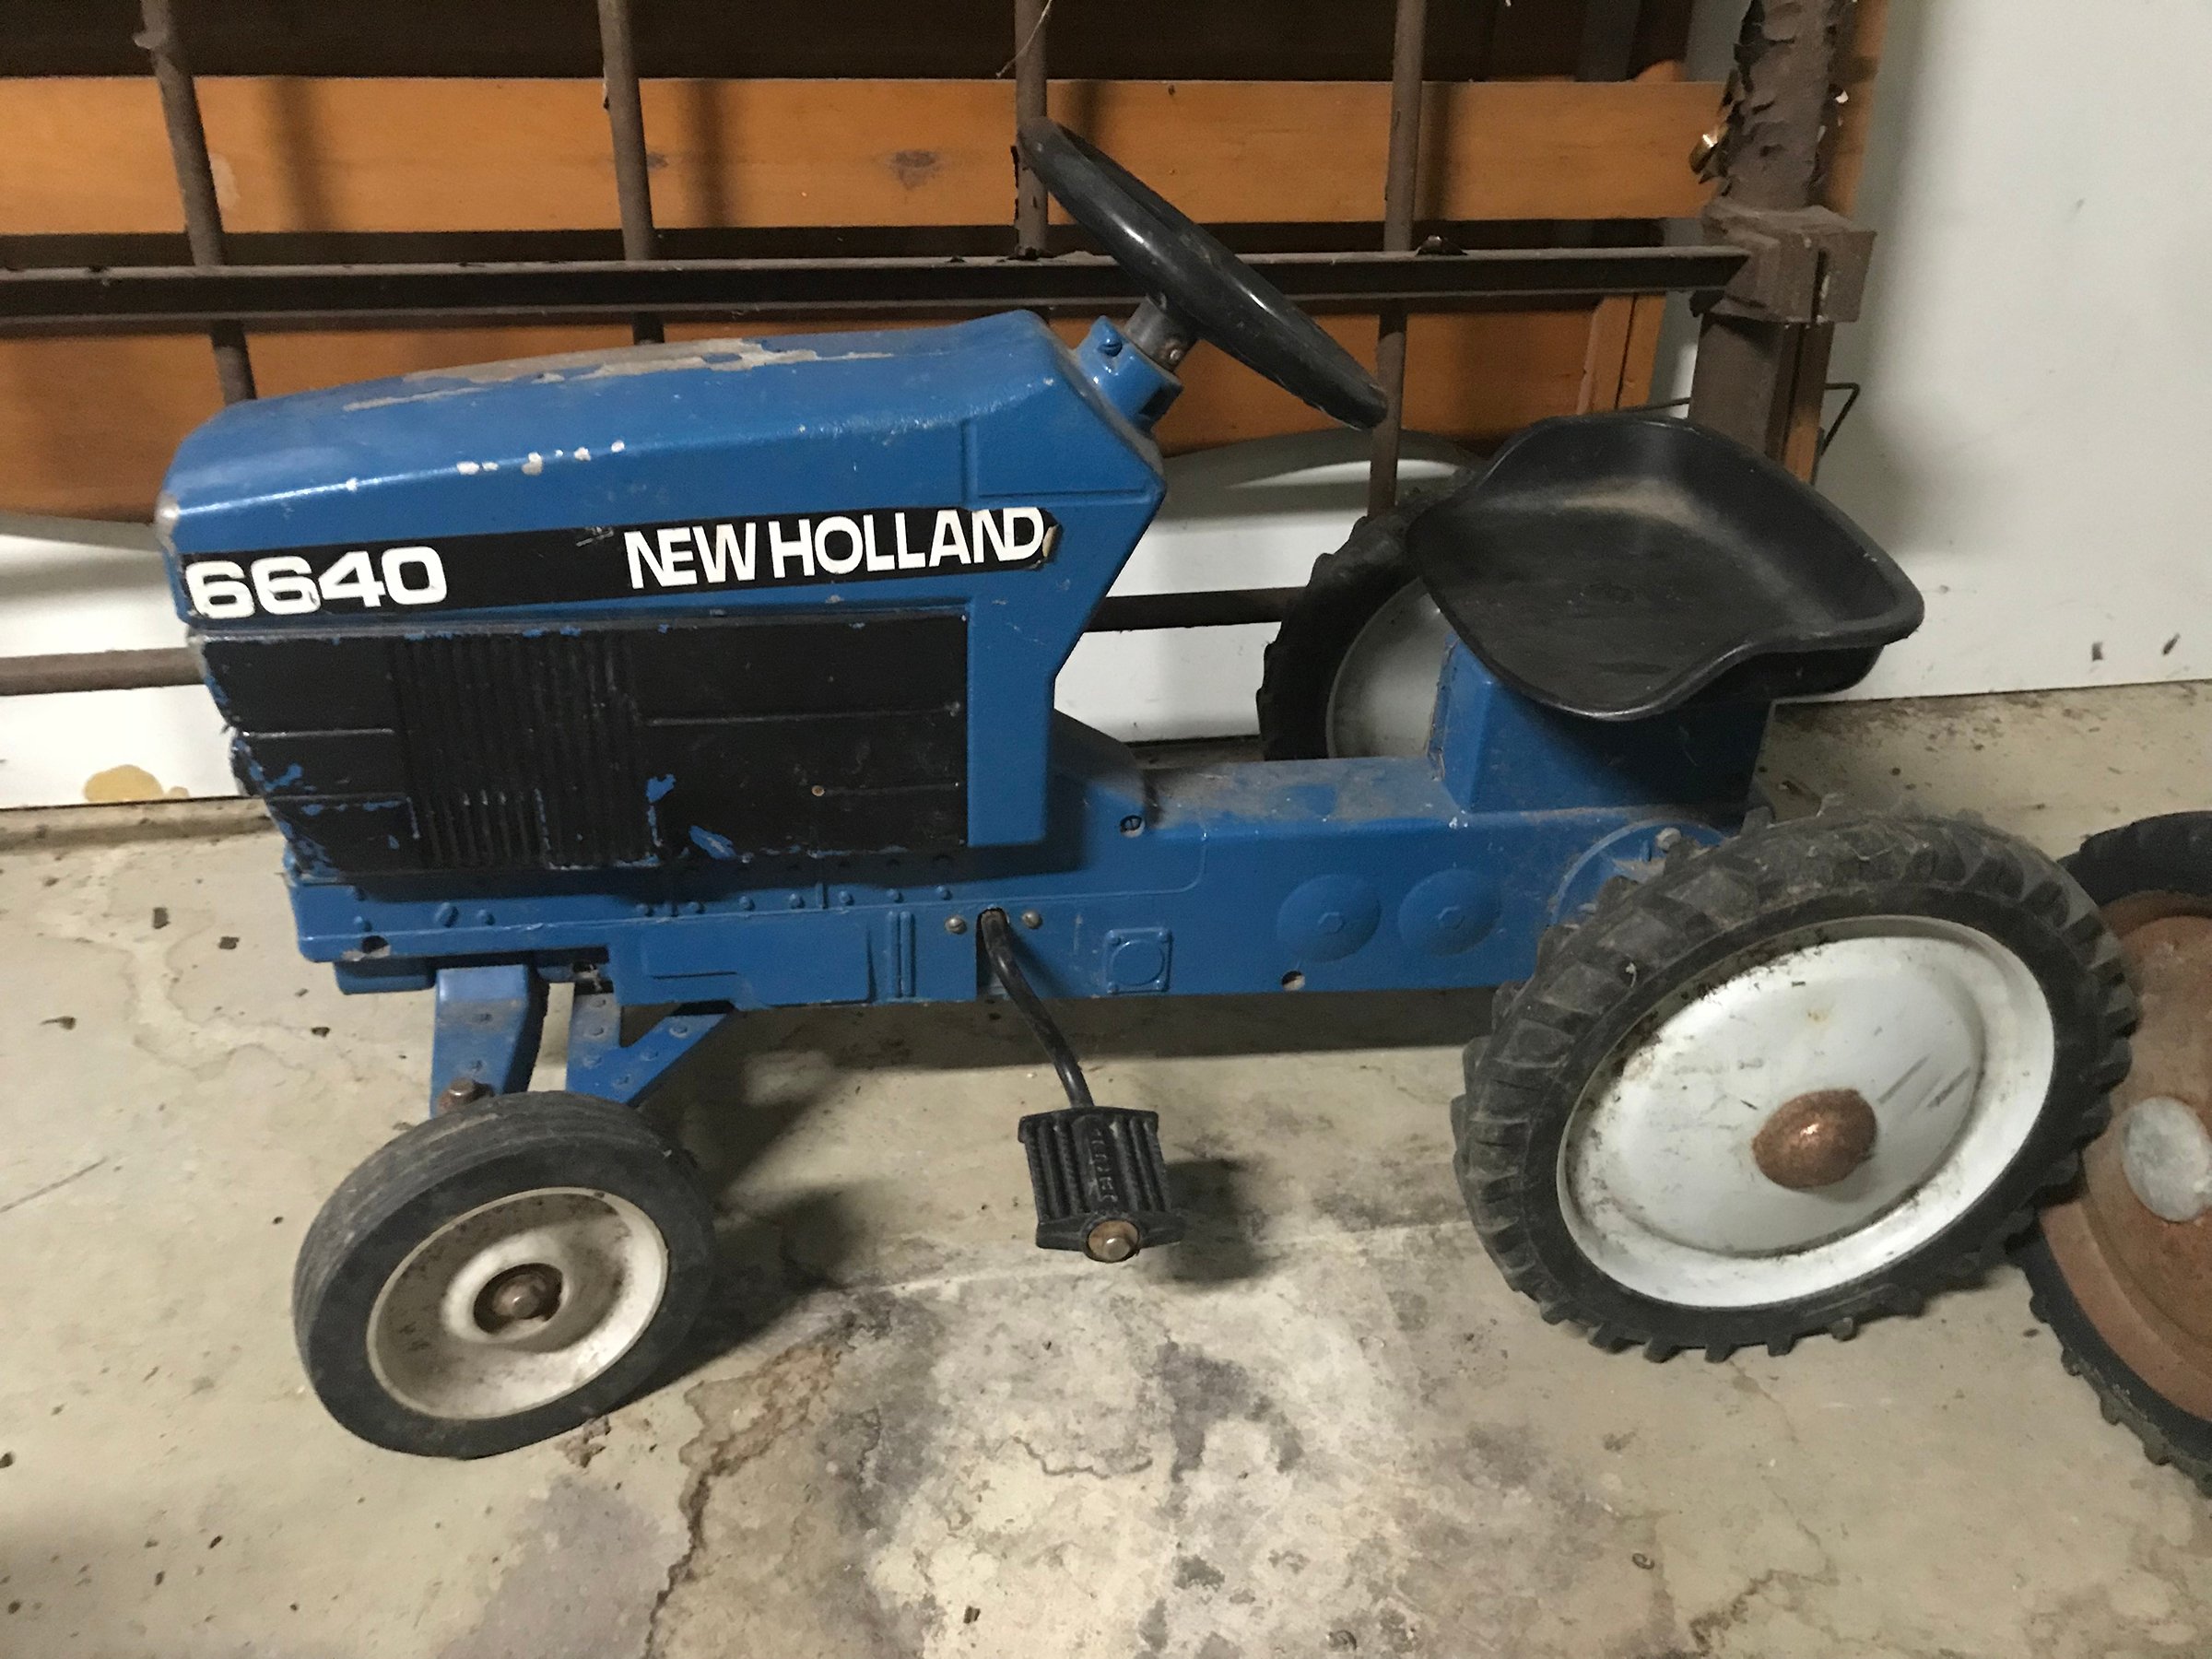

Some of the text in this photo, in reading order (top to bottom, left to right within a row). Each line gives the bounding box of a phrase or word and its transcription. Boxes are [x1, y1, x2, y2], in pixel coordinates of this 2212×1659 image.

[185, 546, 447, 618] 6640
[623, 507, 1044, 589] NEW HOLLAND
